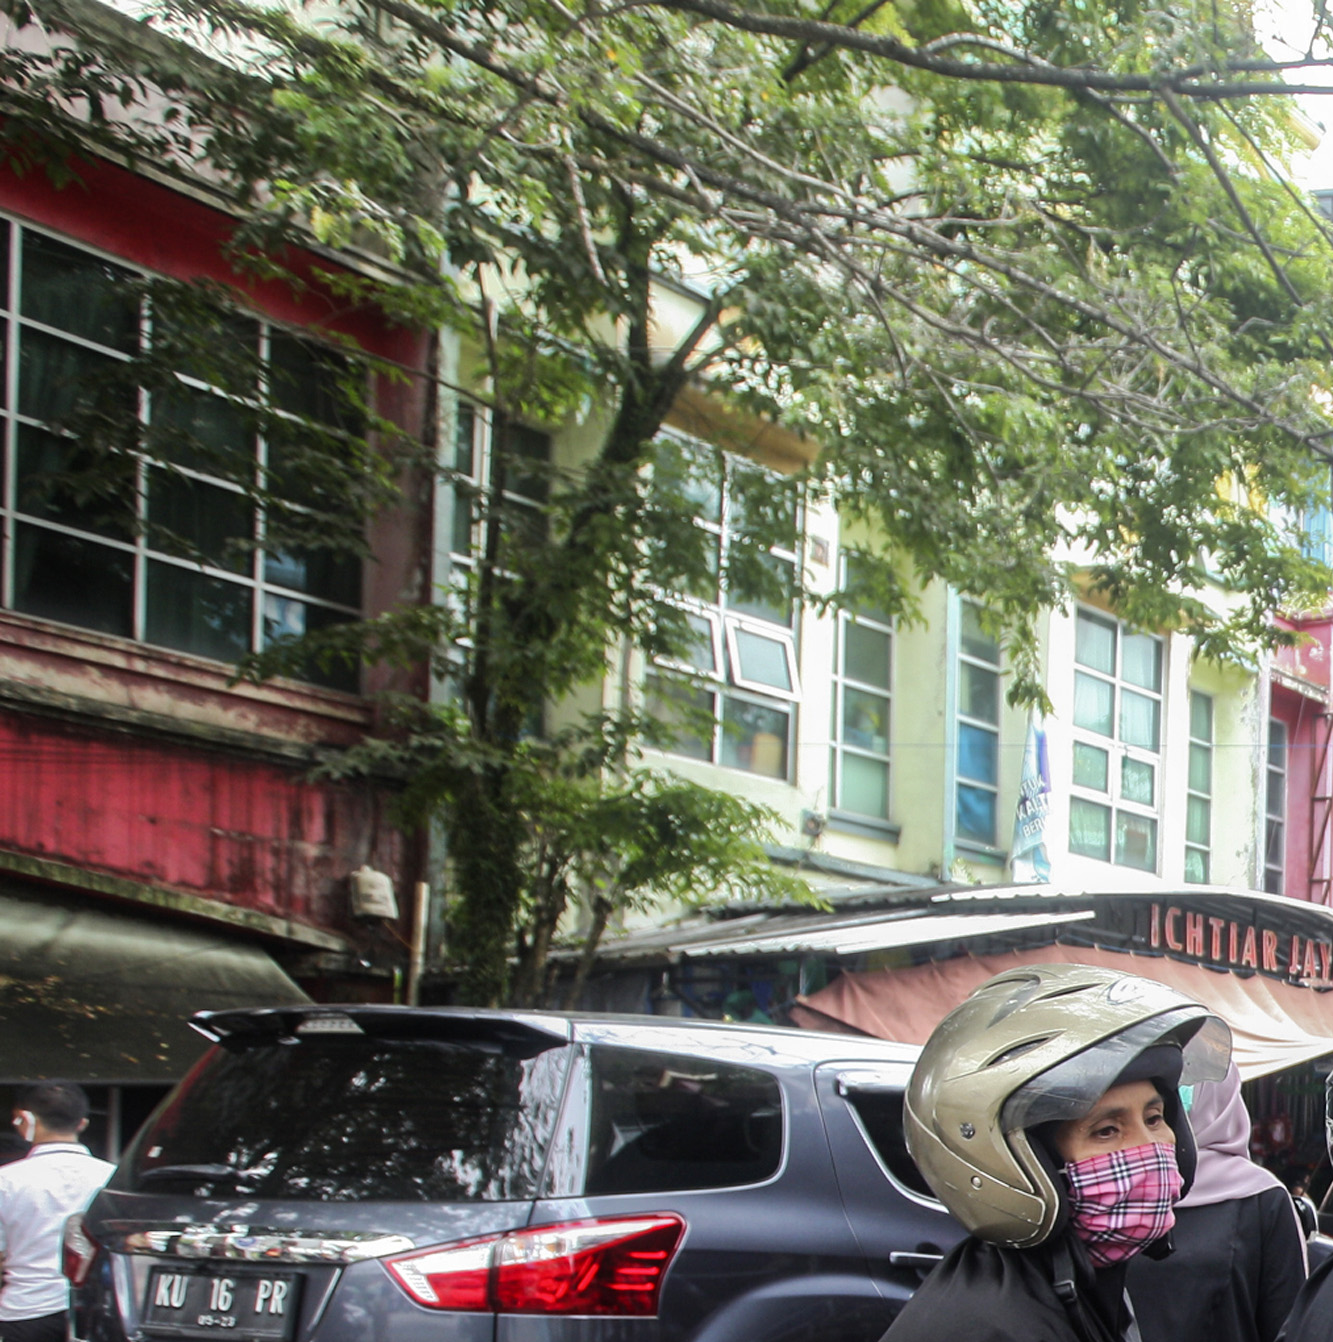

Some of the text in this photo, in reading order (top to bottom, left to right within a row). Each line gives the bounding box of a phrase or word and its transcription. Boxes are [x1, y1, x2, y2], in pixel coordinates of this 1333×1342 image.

[1150, 903, 1279, 972] ICHTIAR
[155, 1274, 288, 1314] KU 16 PR
